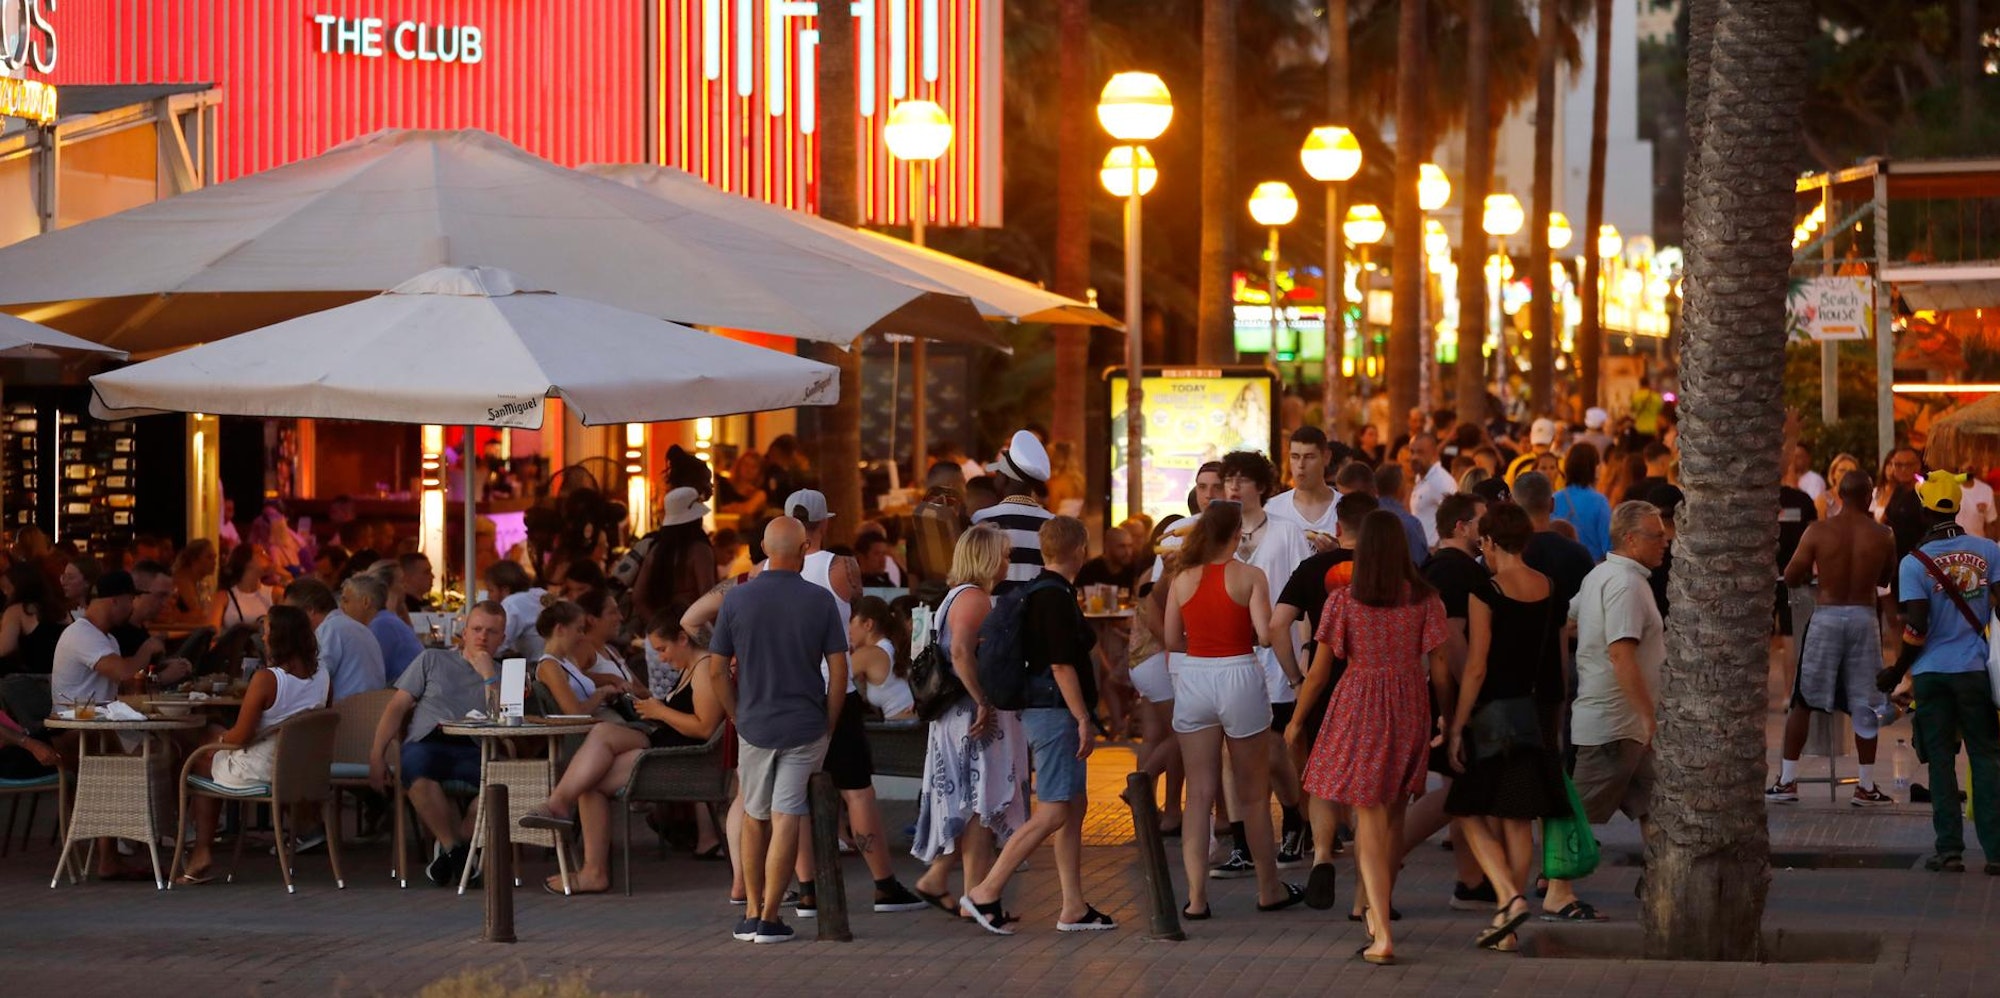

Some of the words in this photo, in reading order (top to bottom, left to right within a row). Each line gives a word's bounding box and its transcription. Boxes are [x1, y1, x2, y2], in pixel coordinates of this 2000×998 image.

[0, 0, 57, 74] OS
[314, 14, 383, 57] THE
[394, 21, 483, 64] CLUB
[1820, 291, 1858, 306] Beach
[1818, 306, 1856, 320] house
[1171, 384, 1206, 392] TODAY
